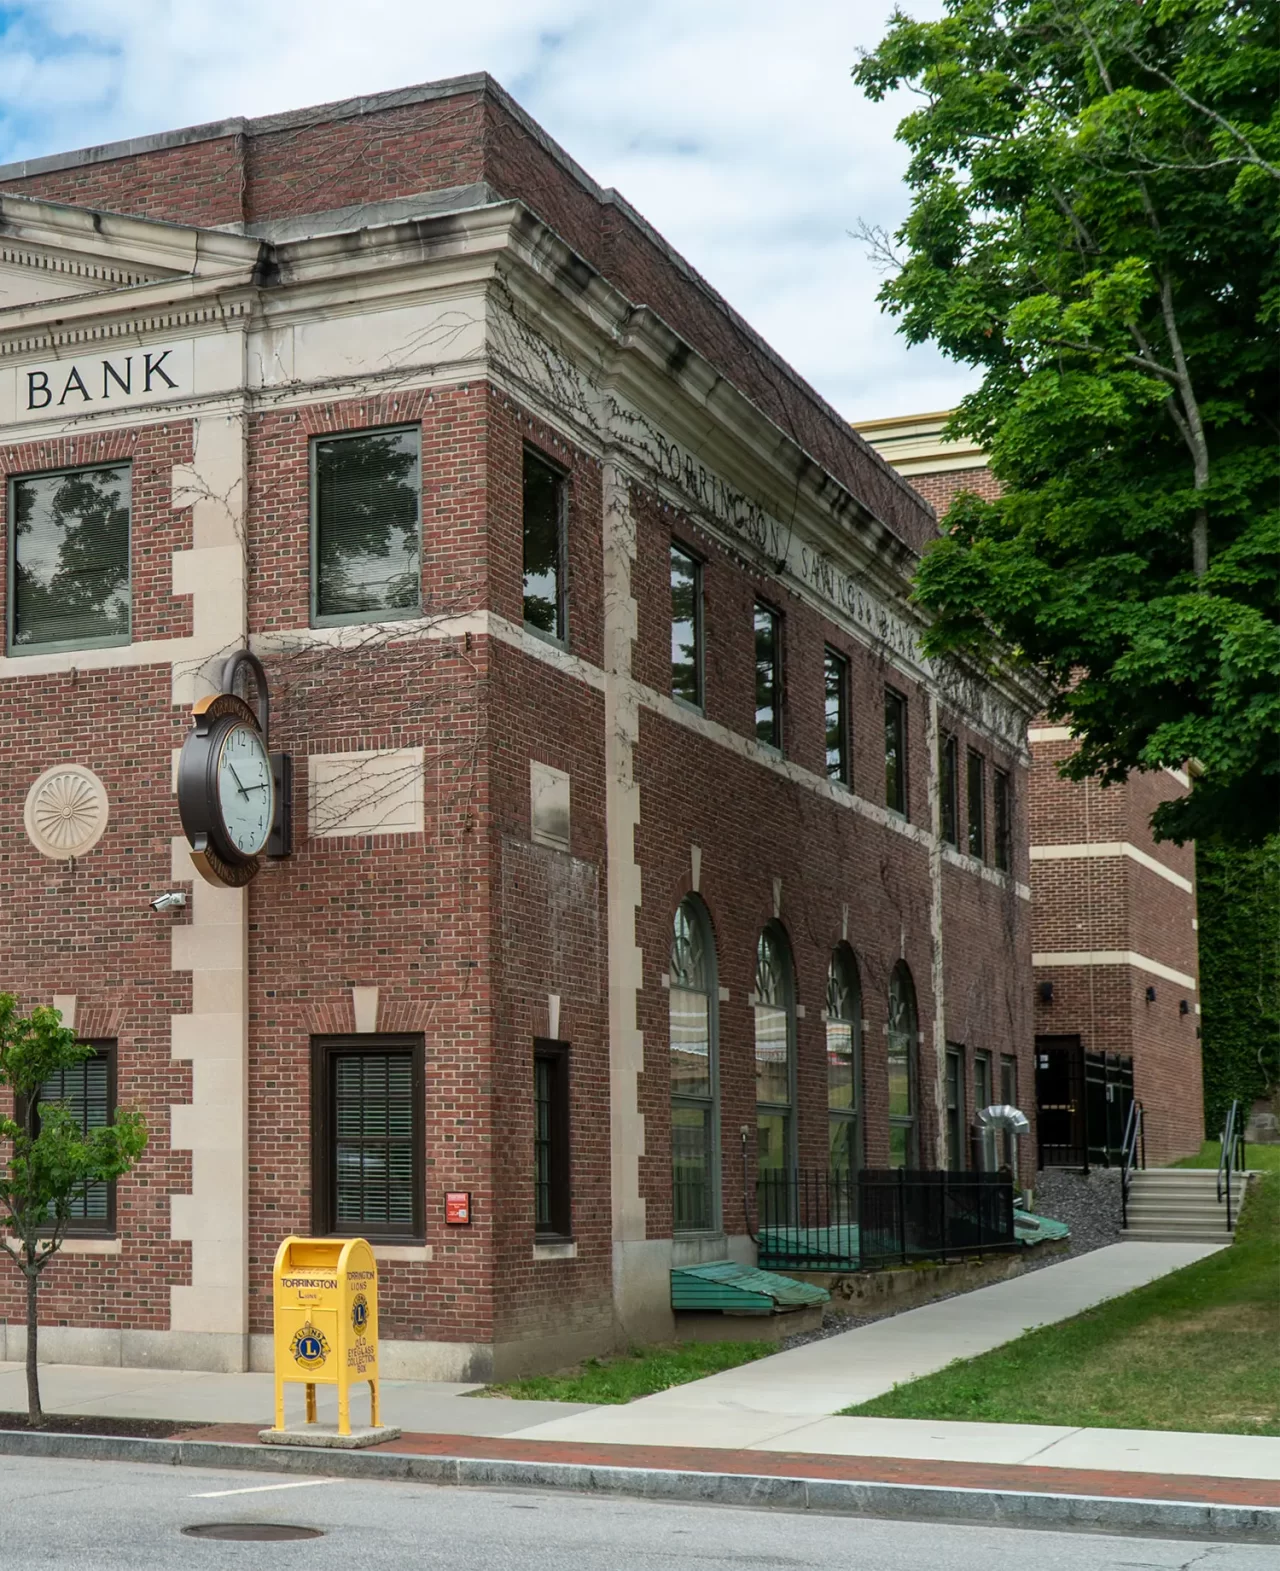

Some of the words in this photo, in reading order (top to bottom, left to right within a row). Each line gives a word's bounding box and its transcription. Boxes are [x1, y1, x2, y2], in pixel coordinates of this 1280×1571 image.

[26, 350, 179, 410] BANK
[656, 432, 780, 562] TORRINGTON
[801, 547, 864, 621] SAVINGS
[879, 610, 916, 661] BANK
[237, 730, 246, 747] 12
[258, 761, 264, 777] 2
[258, 815, 263, 831] 4
[238, 835, 244, 851] 6
[250, 831, 255, 848] 5
[346, 1270, 375, 1281] TORRINGTON
[281, 1278, 338, 1290] TORRINGTON
[351, 1281, 367, 1291] LIONS
[298, 1329, 322, 1339] LINS
[305, 1340, 317, 1356] L
[355, 1337, 367, 1348] OLD
[348, 1345, 374, 1358] EYEGLASS
[348, 1355, 376, 1368] COLLECTION
[357, 1364, 367, 1374] BOX
